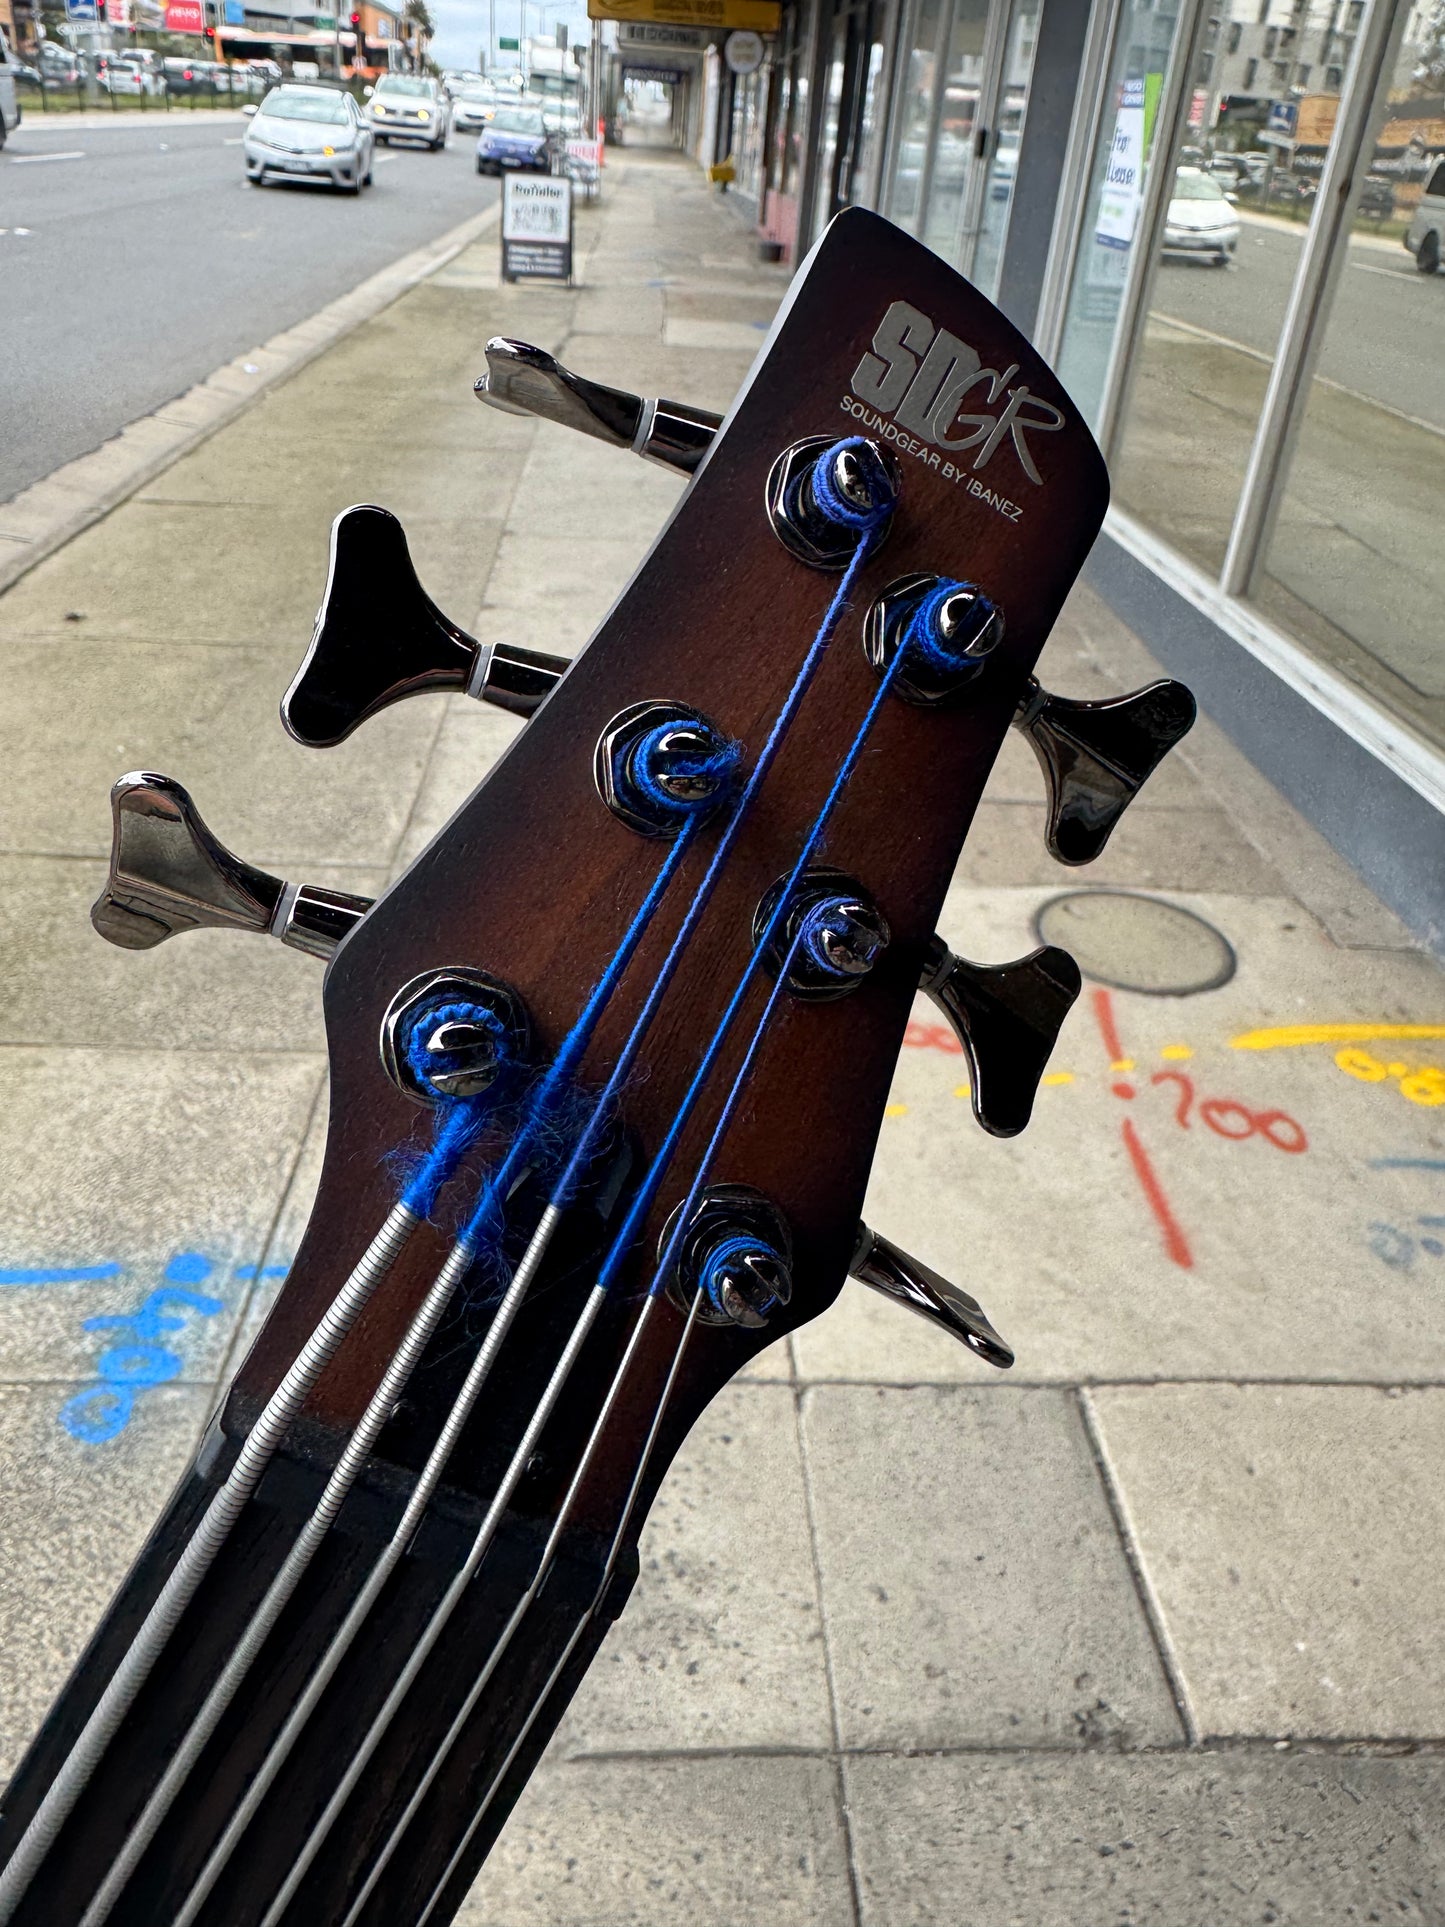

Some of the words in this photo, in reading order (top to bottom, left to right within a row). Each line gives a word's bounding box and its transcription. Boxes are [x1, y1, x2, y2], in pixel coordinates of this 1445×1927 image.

[840, 395, 940, 470] SOUNDGEAR
[941, 461, 968, 484] BY
[966, 477, 1024, 523] IBANEZ
